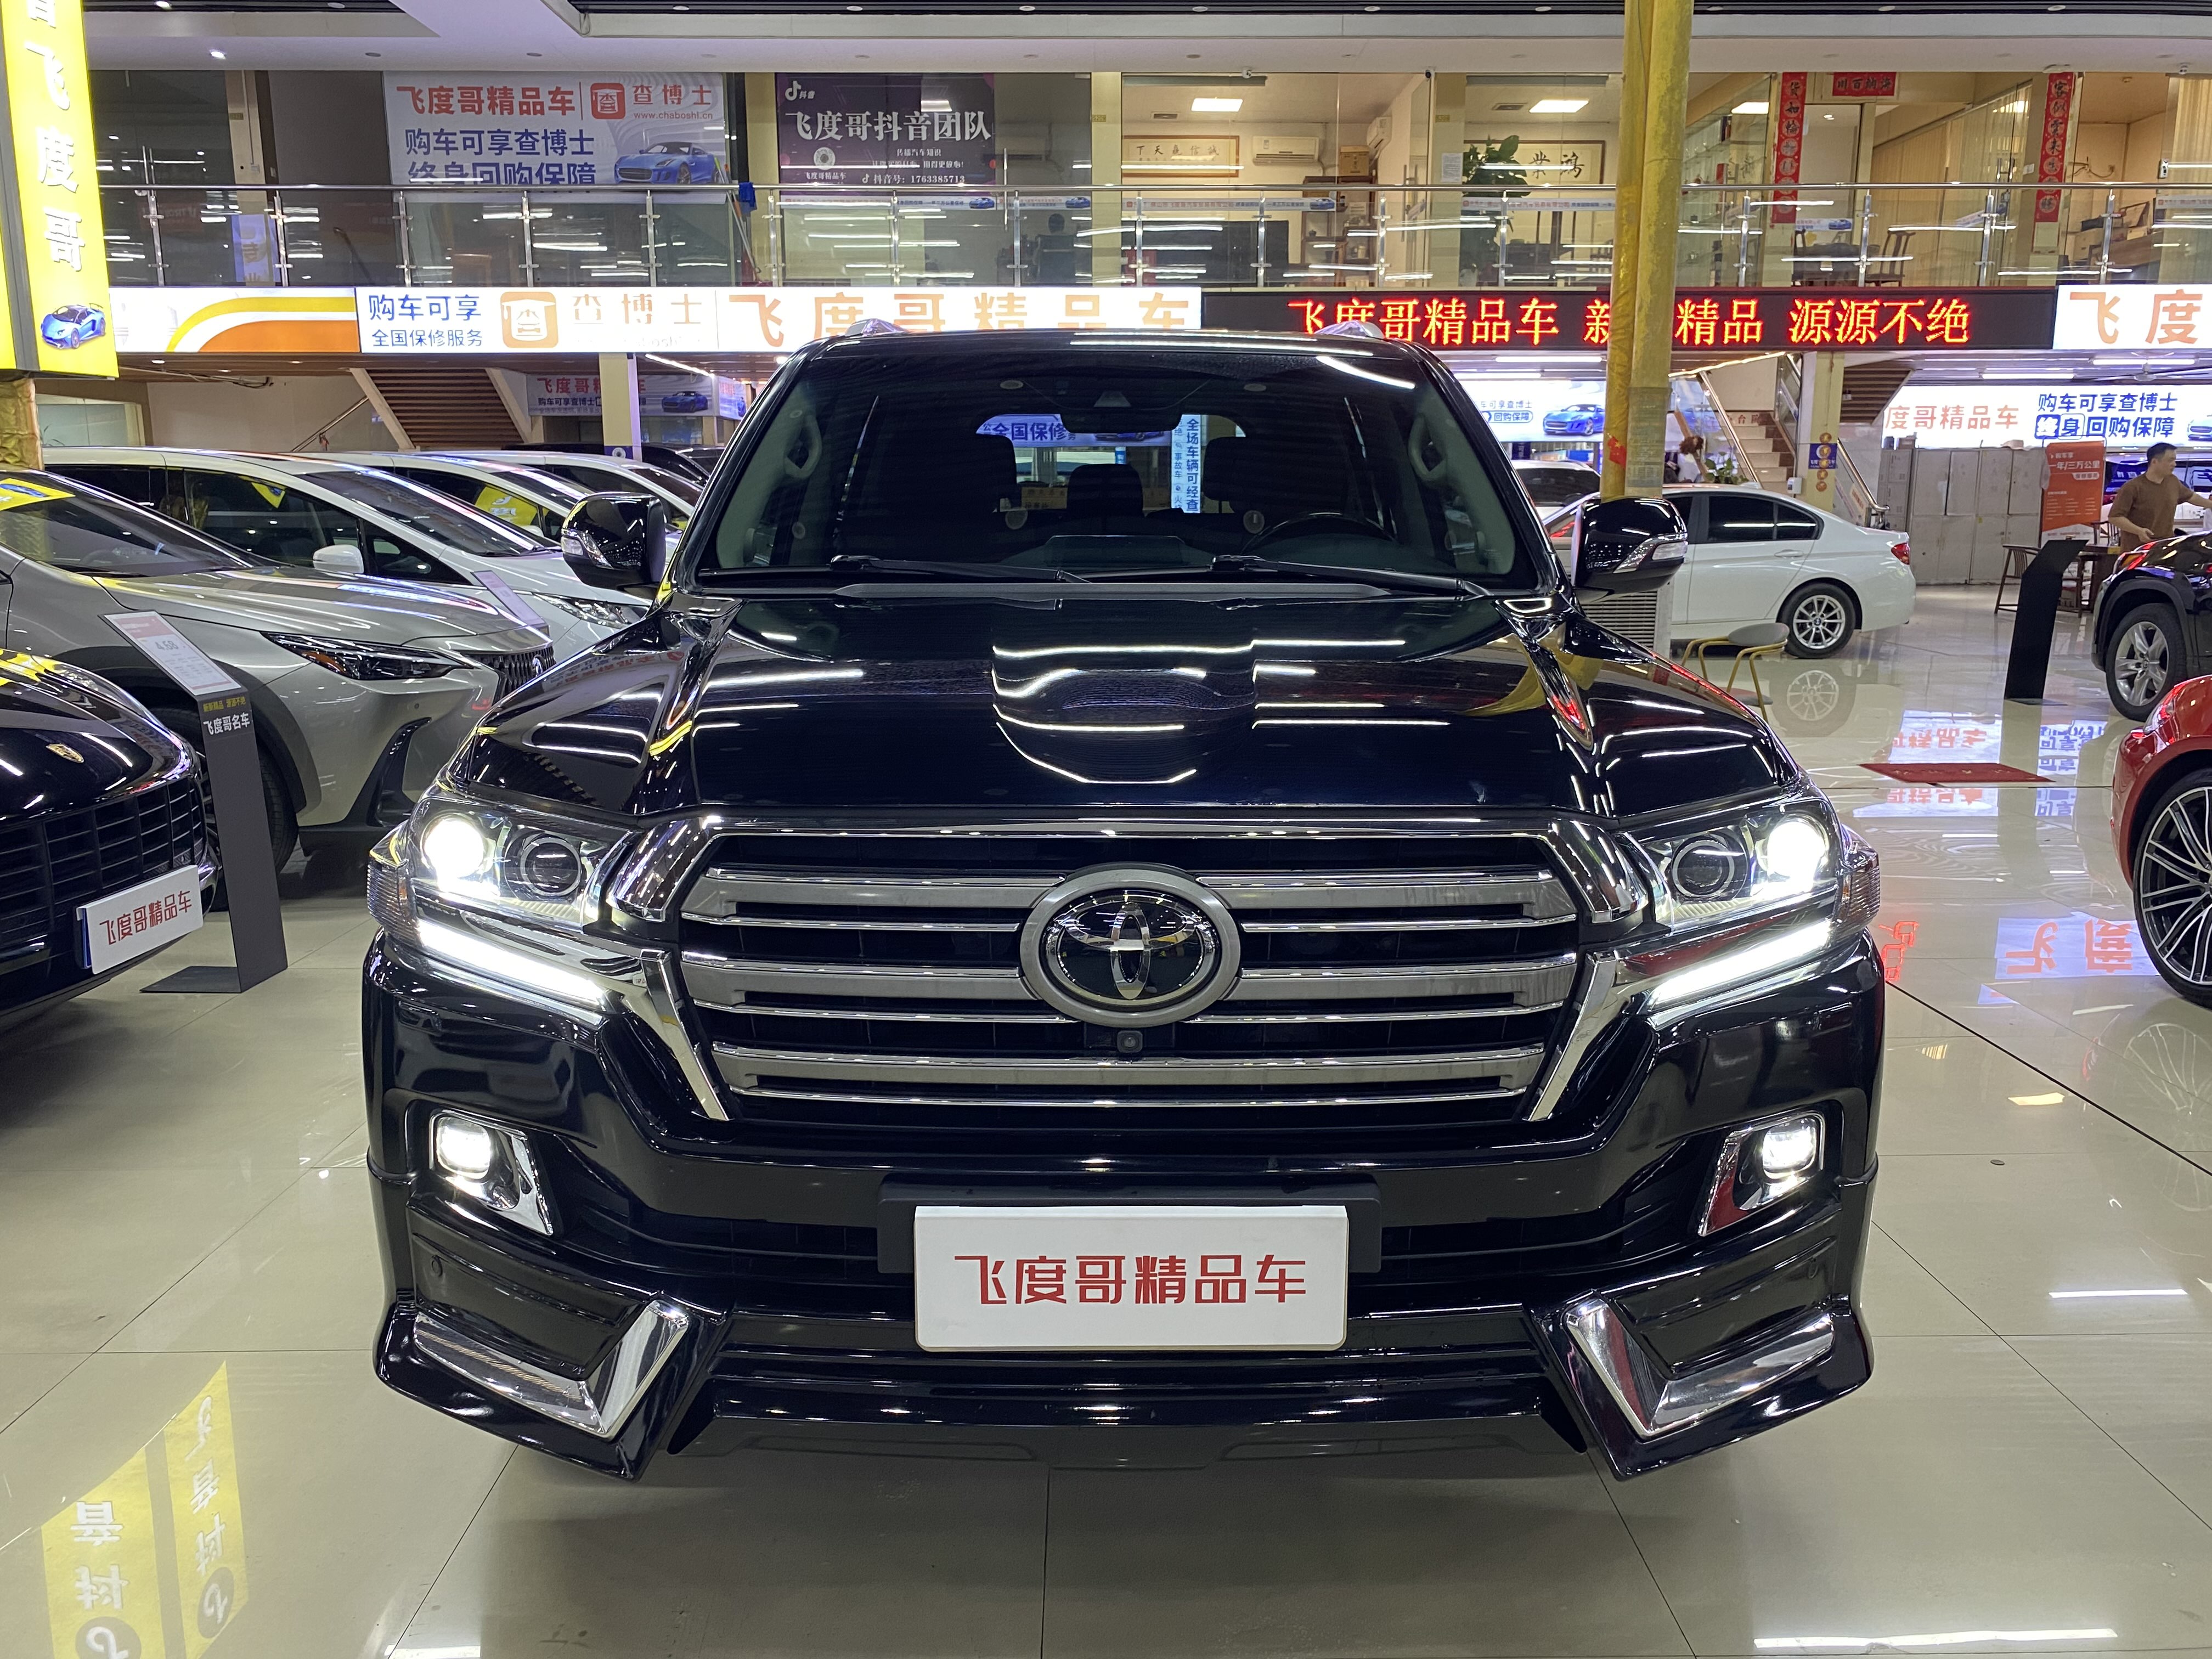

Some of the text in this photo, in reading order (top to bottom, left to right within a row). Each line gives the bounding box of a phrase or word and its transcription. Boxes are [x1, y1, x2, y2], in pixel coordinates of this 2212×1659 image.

[396, 85, 575, 116] 飞度哥精品车
[633, 84, 712, 105] 查博士
[785, 110, 992, 142] 飞度哥抖音团队
[405, 128, 595, 156] 购车可享查博士
[408, 161, 596, 185] 终身回购保障
[368, 294, 481, 321] 购车可享
[572, 294, 703, 325] 查博士
[729, 291, 1189, 347] 飞度哥精品车
[1288, 297, 1559, 346] 飞度哥精品车
[1788, 298, 1971, 345] 源源不绝
[2069, 289, 2203, 345] 飞度
[372, 329, 483, 347] 全国保修服务
[1475, 400, 1532, 409] 车可享查博士
[2038, 392, 2178, 413] 购车可享查博士
[1186, 418, 1199, 511] 全场车辆可经查
[203, 712, 250, 735] 飞度哥名车
[99, 890, 191, 945] 飞度哥精品车
[954, 1254, 1306, 1305] 飞度哥精品车
